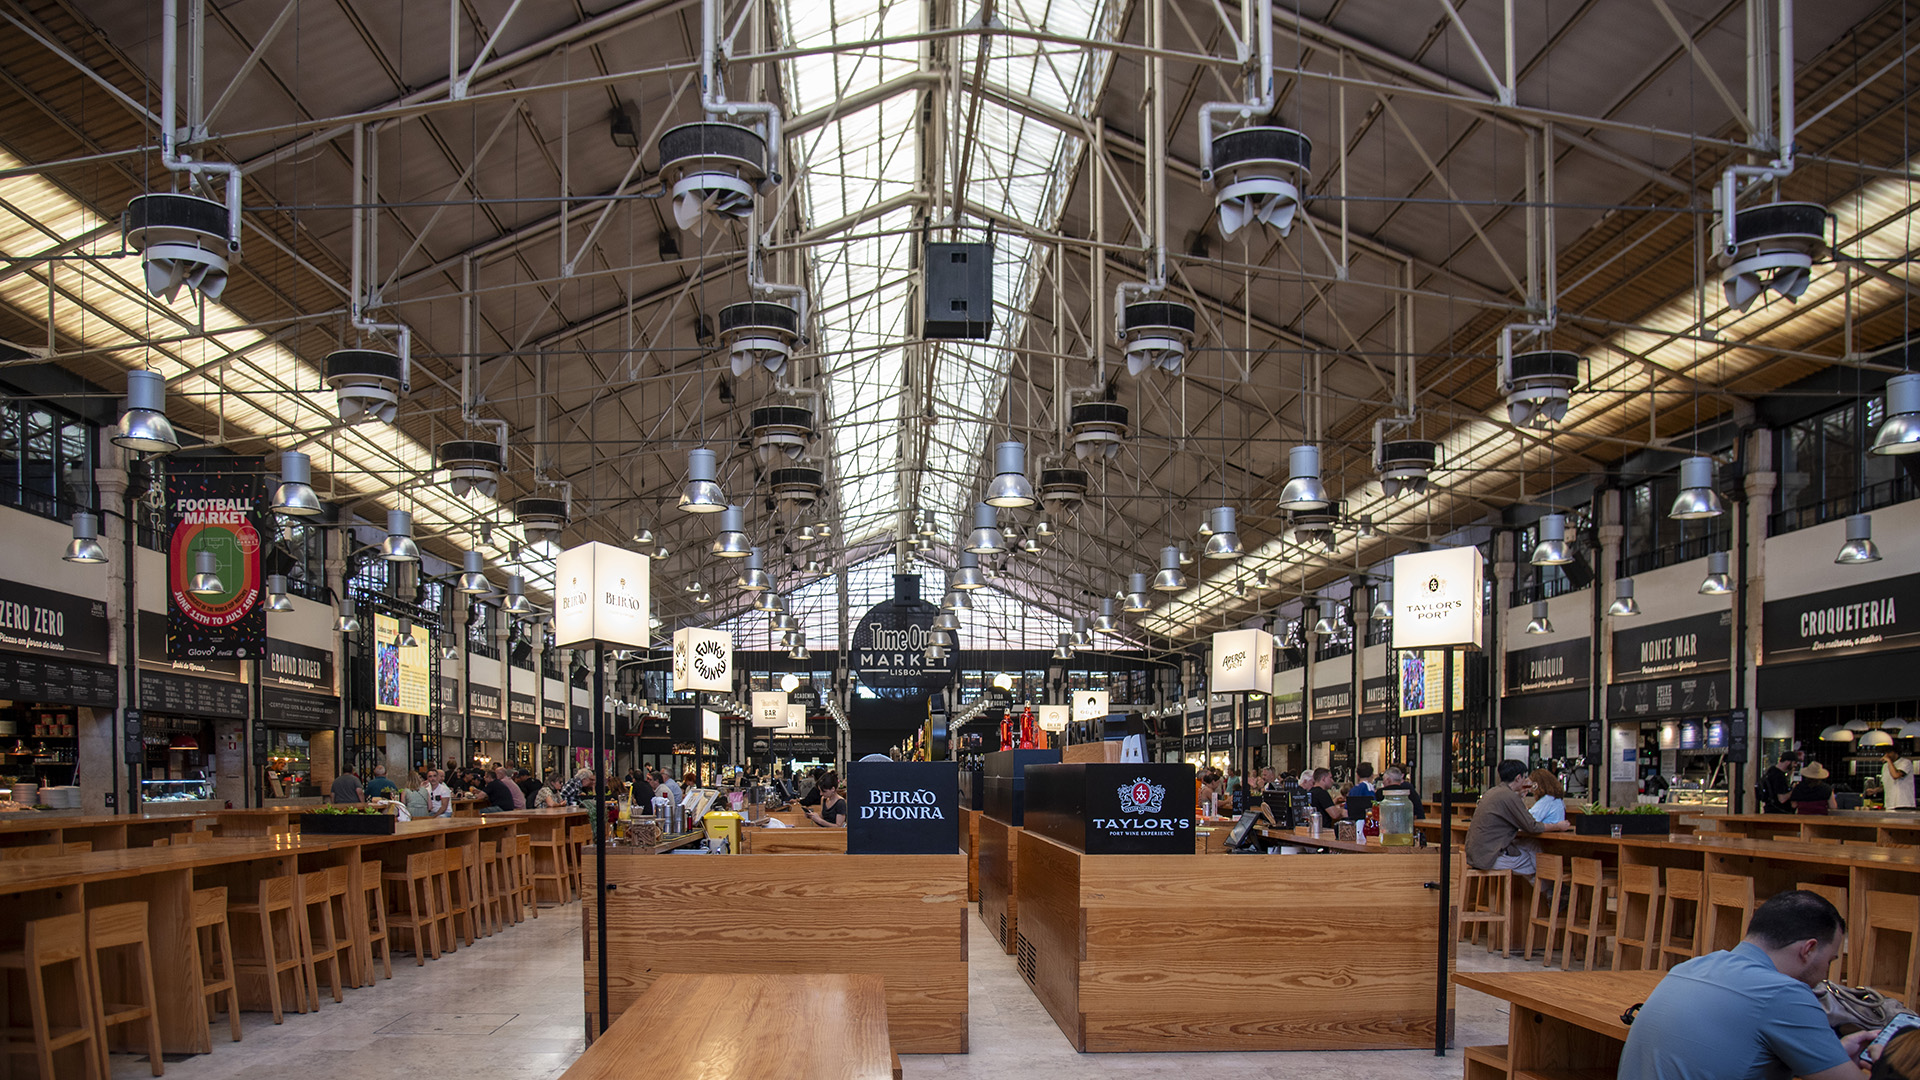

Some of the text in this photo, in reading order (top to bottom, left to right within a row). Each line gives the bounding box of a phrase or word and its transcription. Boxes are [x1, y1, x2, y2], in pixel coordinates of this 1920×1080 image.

[177, 498, 254, 512] FOOTBALL
[184, 512, 247, 524] MARKET
[175, 588, 258, 625] JUNE 11TH TO JULY 19TH
[606, 592, 640, 610] BEIRÃO
[1406, 600, 1462, 613] TAYLOR'S
[0, 600, 30, 631] ZERO
[34, 606, 64, 637] ZERO
[1418, 610, 1449, 620] PORT
[1800, 597, 1896, 638] CROQUETERIA
[26, 637, 42, 648] forno
[696, 640, 725, 659] FUNKY
[1641, 633, 1697, 663] MONTE MAR
[188, 646, 215, 656] Glovo
[1222, 651, 1246, 667] APEROL
[271, 652, 297, 676] GROUND
[298, 658, 322, 680] BURGER
[860, 654, 950, 666] MARKET
[1530, 656, 1564, 680] PINÓQUIO
[694, 658, 726, 680] CHUNKY
[1657, 684, 1672, 697] PEIXE
[869, 788, 936, 805] BEIRÃO
[860, 806, 944, 820] D'HONRA
[1092, 818, 1190, 831] TAYLOR'S
